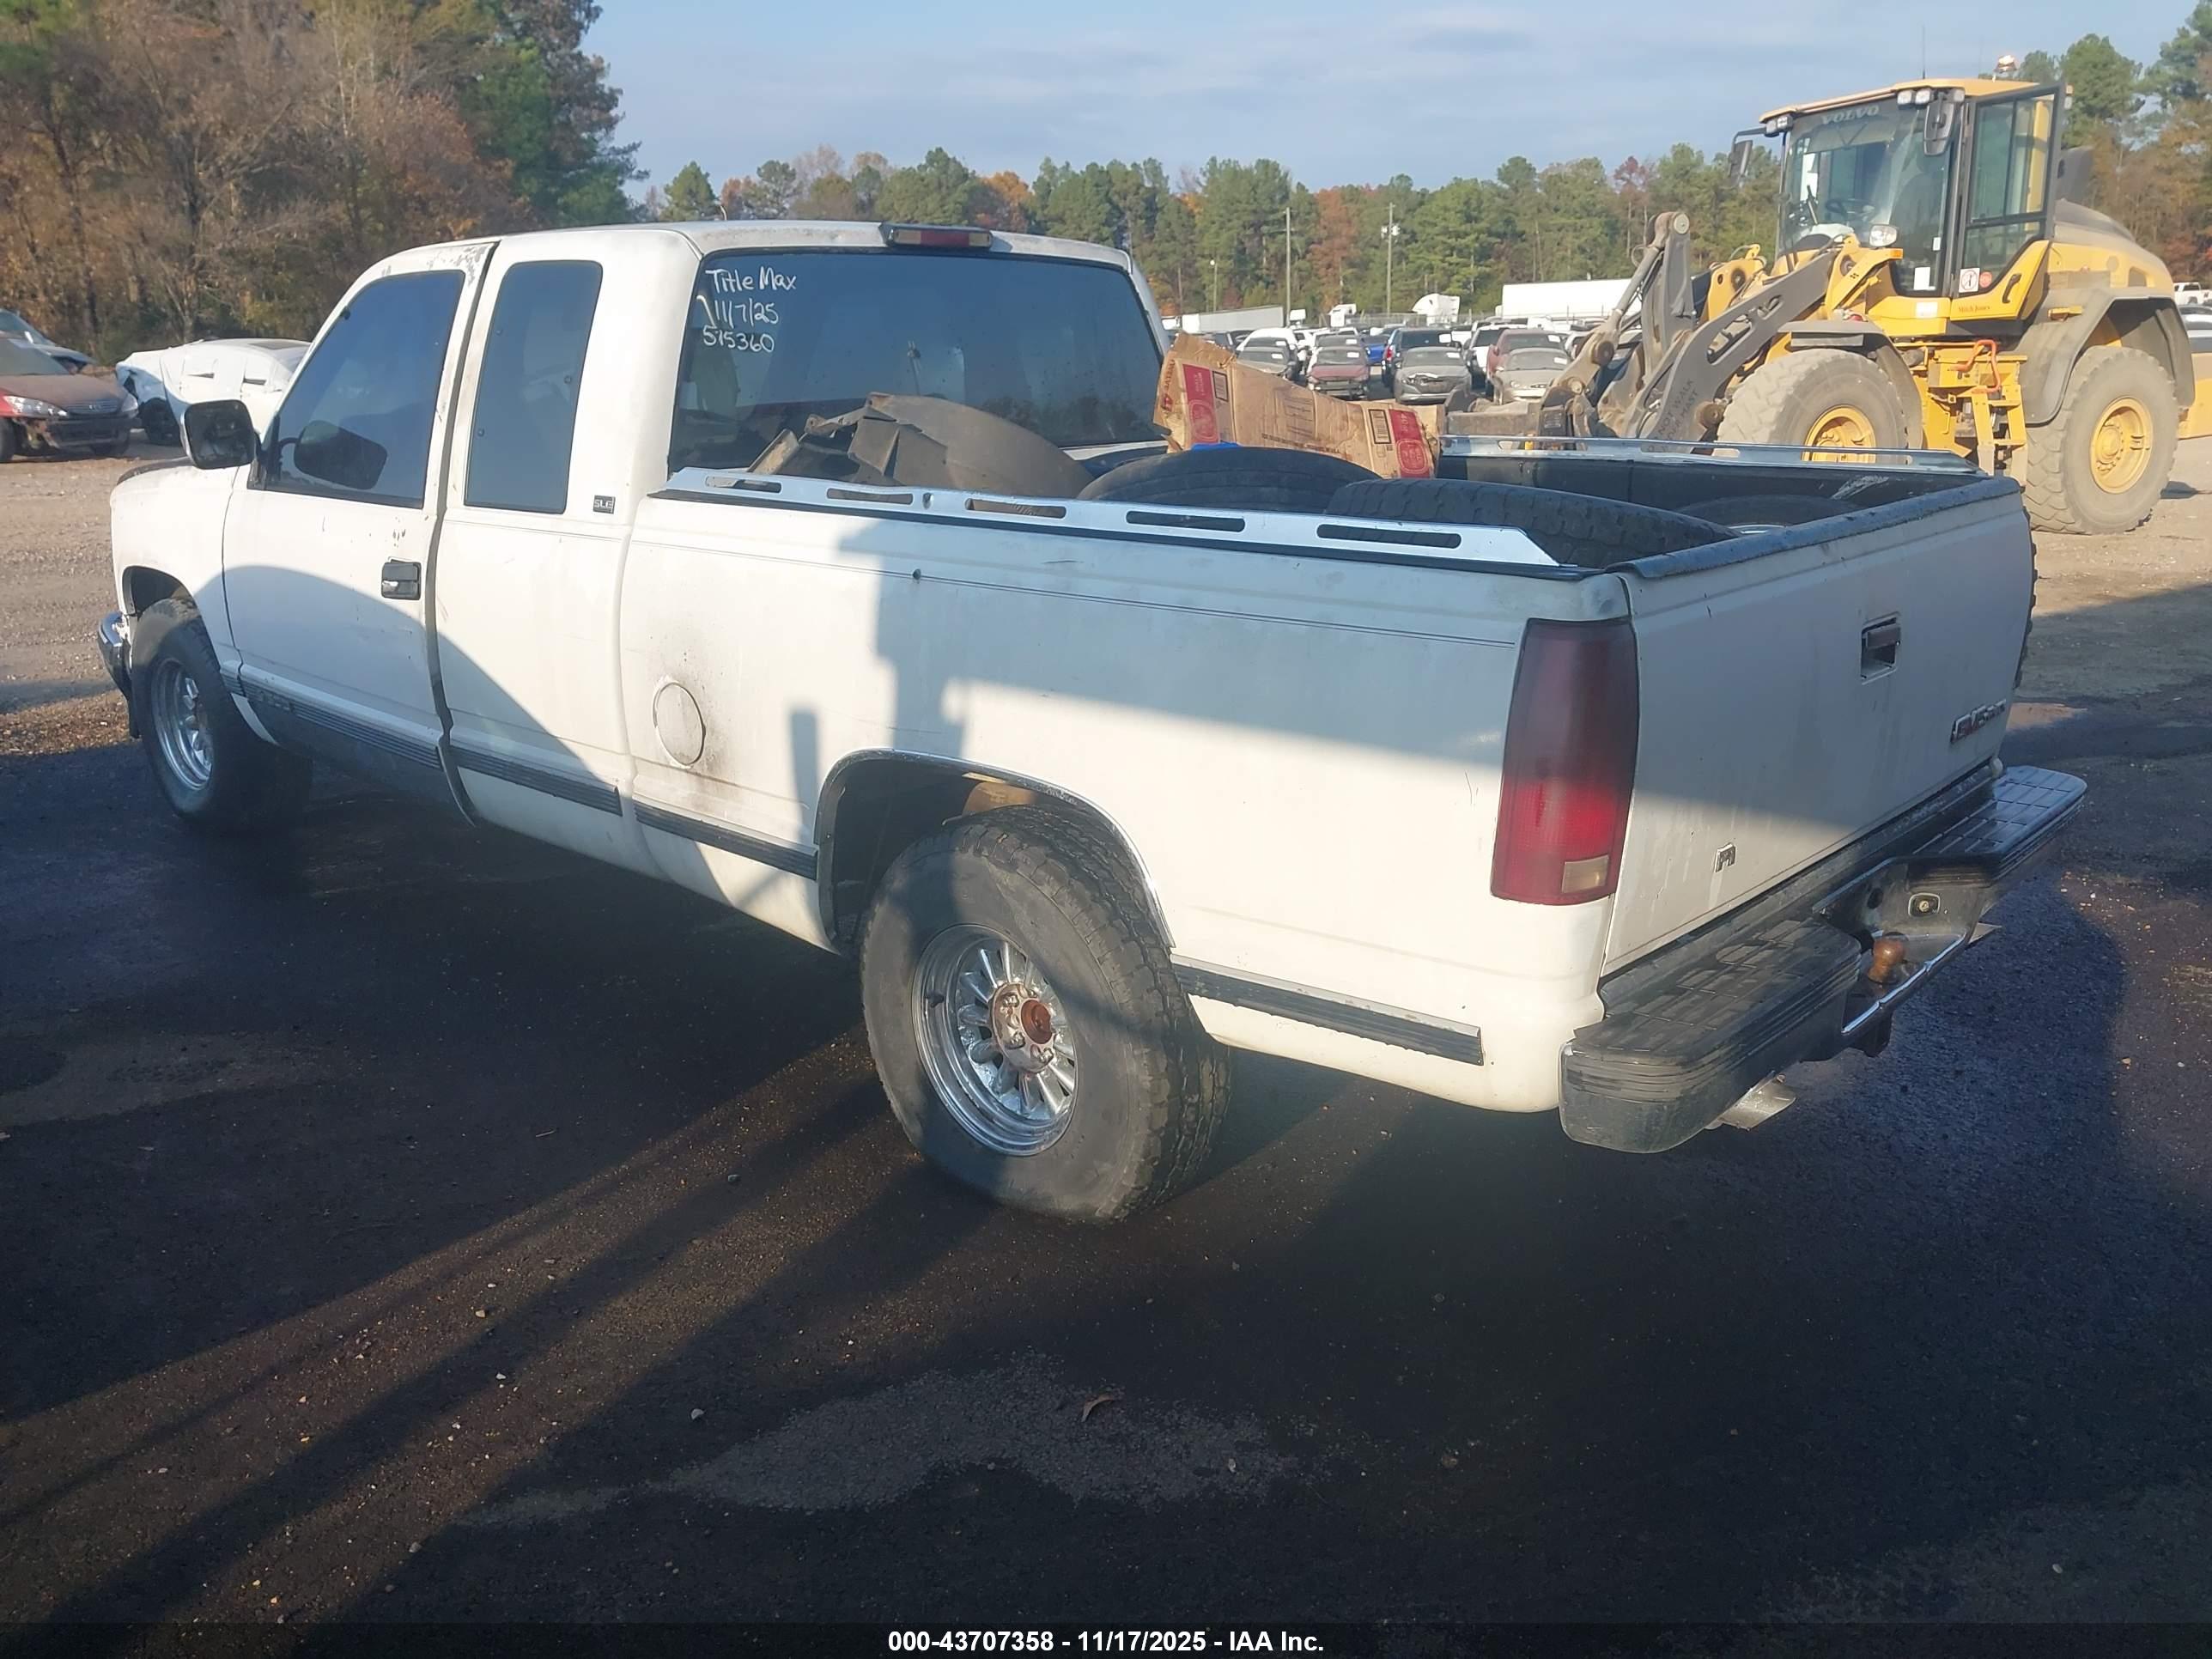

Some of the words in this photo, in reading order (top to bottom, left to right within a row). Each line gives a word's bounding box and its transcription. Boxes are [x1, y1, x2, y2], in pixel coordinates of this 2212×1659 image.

[1821, 105, 1880, 125] VOLVO
[705, 268, 755, 294] Title
[759, 266, 797, 290] Max
